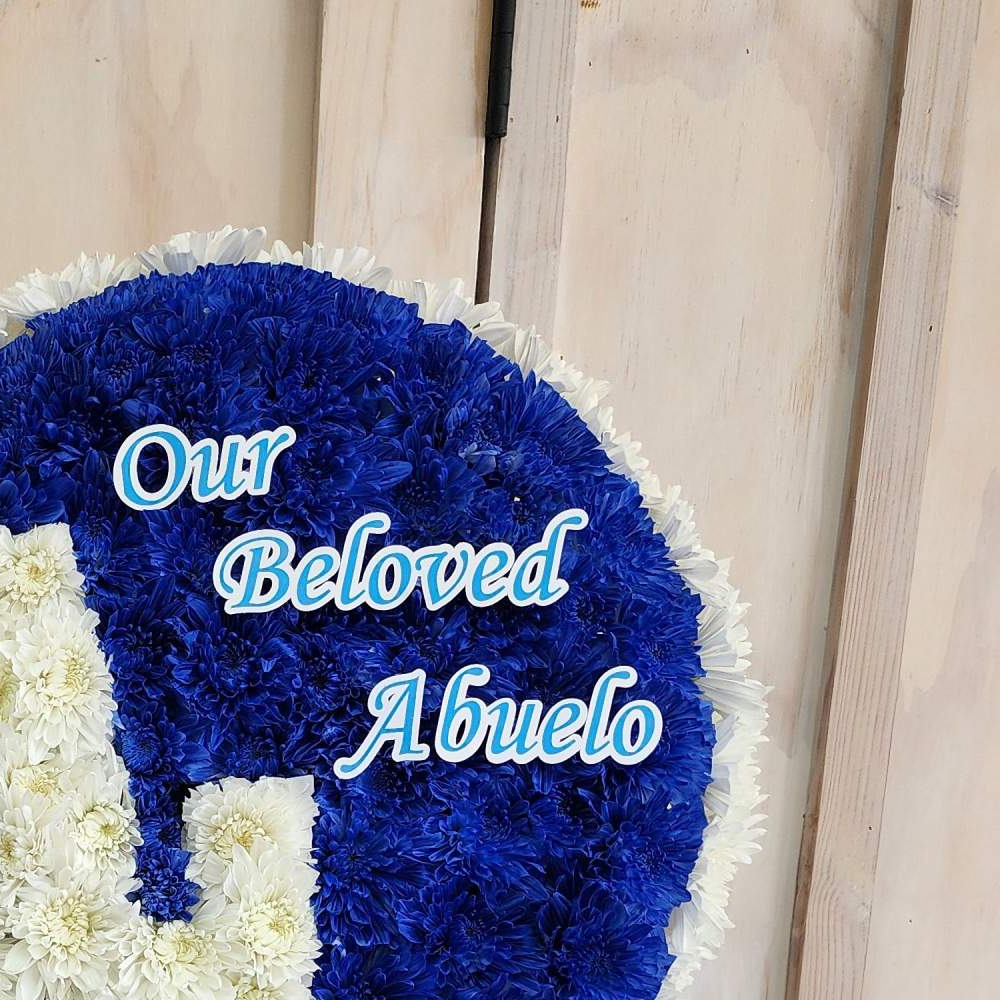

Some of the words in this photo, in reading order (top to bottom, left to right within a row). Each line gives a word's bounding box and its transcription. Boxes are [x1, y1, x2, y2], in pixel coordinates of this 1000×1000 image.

[113, 424, 297, 512] Our
[213, 508, 589, 615] Beloved
[333, 663, 664, 781] Abuelo
